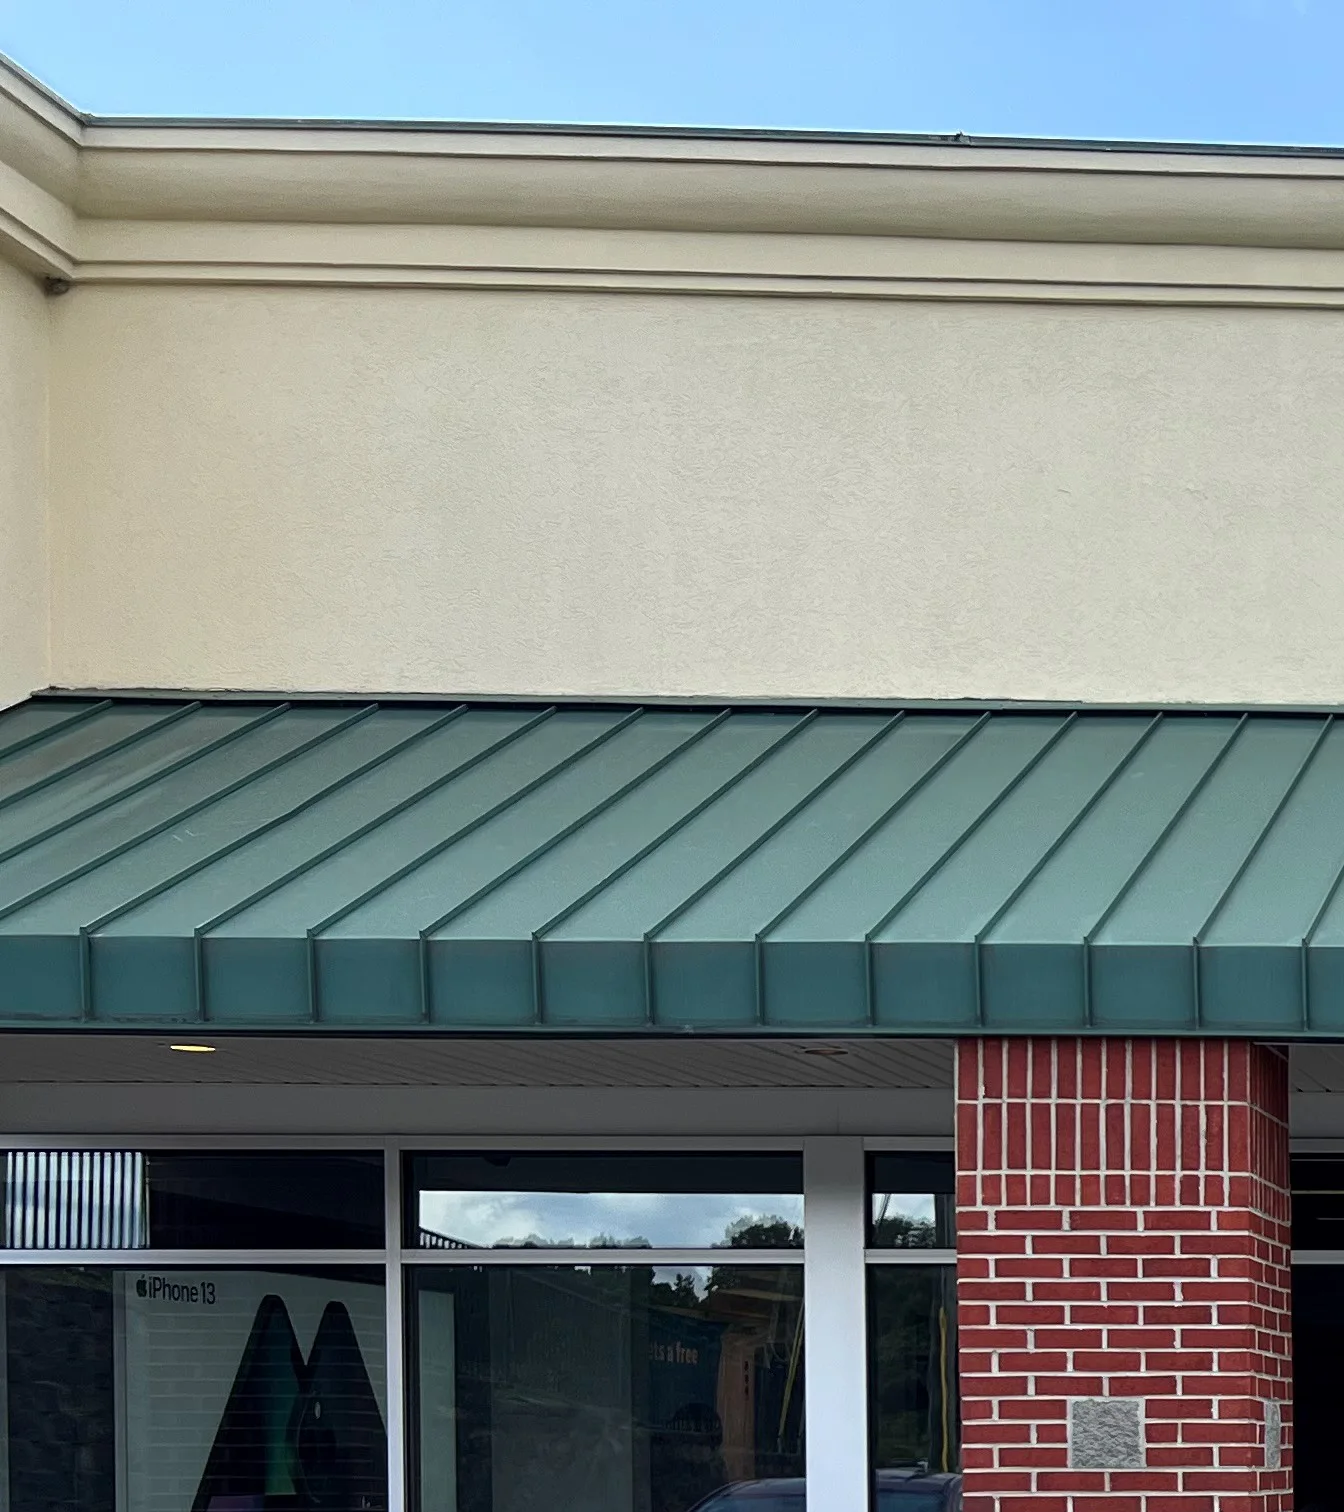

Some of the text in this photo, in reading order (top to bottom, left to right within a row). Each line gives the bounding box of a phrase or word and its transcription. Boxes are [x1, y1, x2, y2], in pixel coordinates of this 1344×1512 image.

[148, 1276, 216, 1305] iPhone 13
[676, 1341, 699, 1364] free
